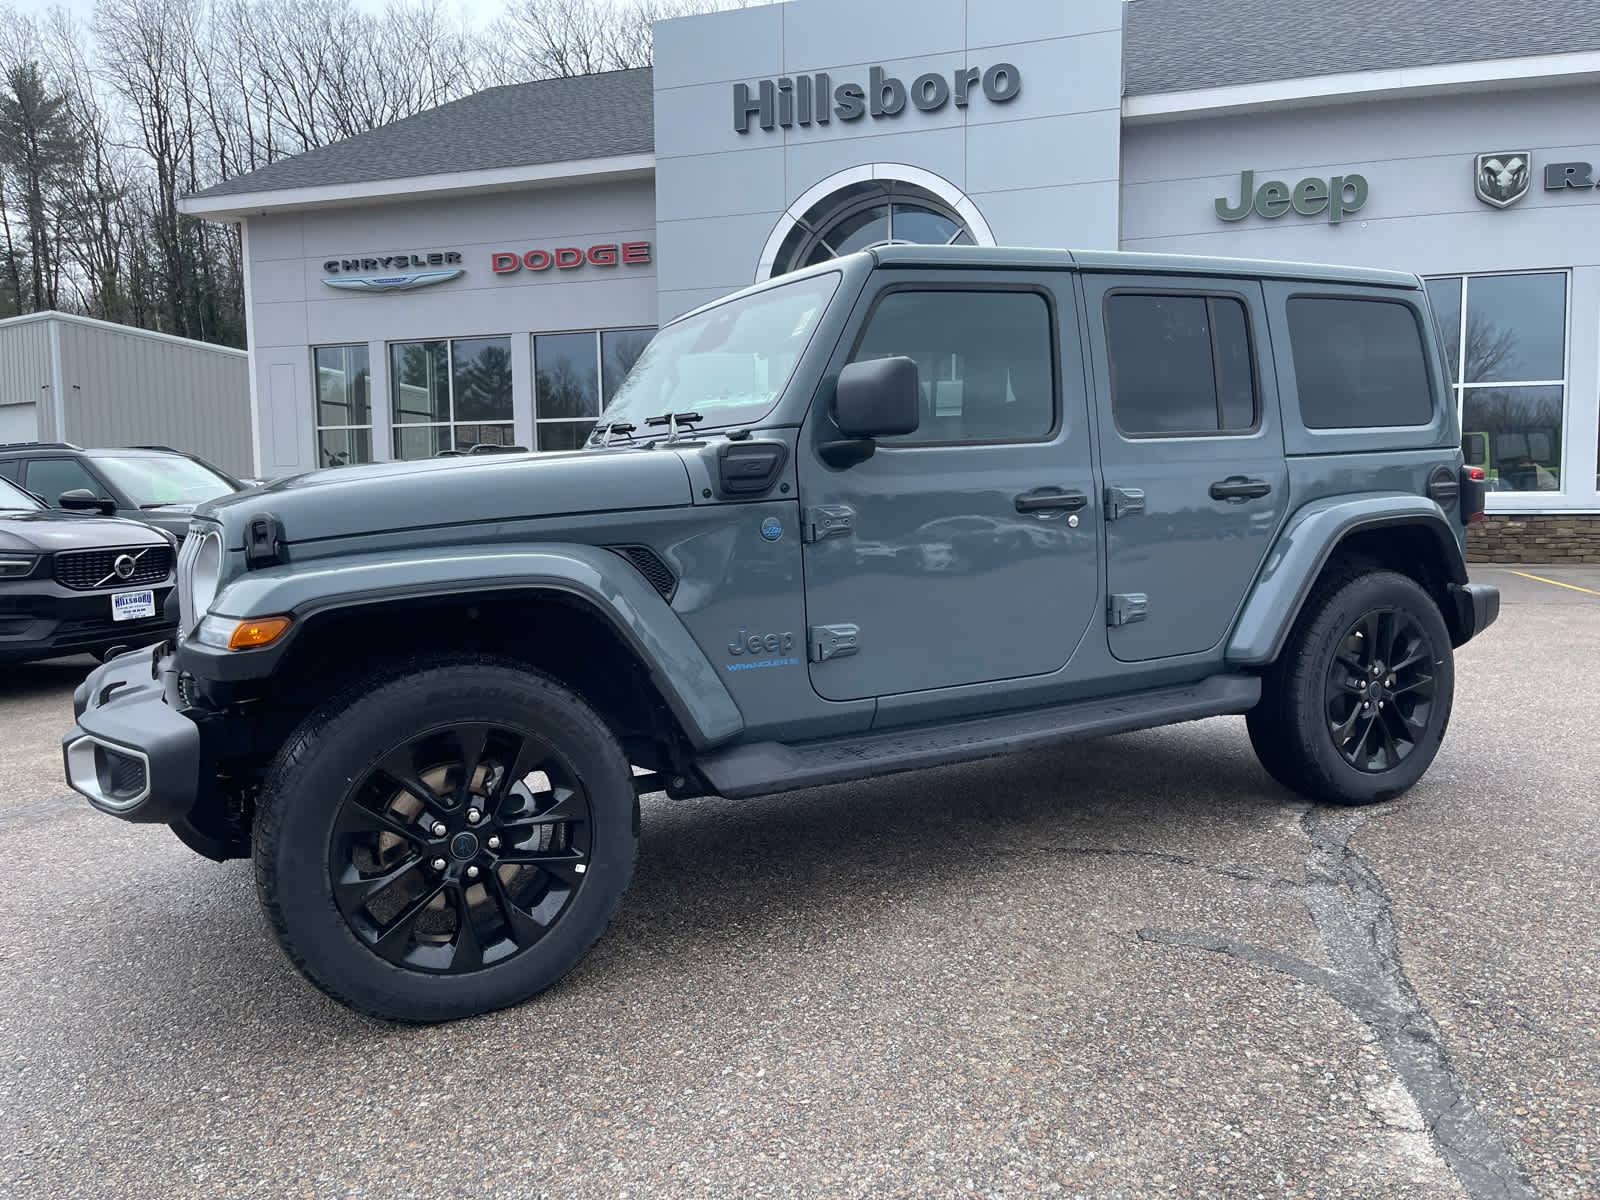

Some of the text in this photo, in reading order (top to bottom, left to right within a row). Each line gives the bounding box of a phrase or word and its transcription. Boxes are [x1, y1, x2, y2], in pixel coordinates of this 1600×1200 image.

[733, 62, 1021, 134] Hillsboro
[1544, 161, 1600, 192] R
[1214, 169, 1369, 224] Jeep
[323, 251, 463, 273] CHRYSLER
[491, 241, 651, 274] DODGE
[728, 629, 793, 656] Jeep
